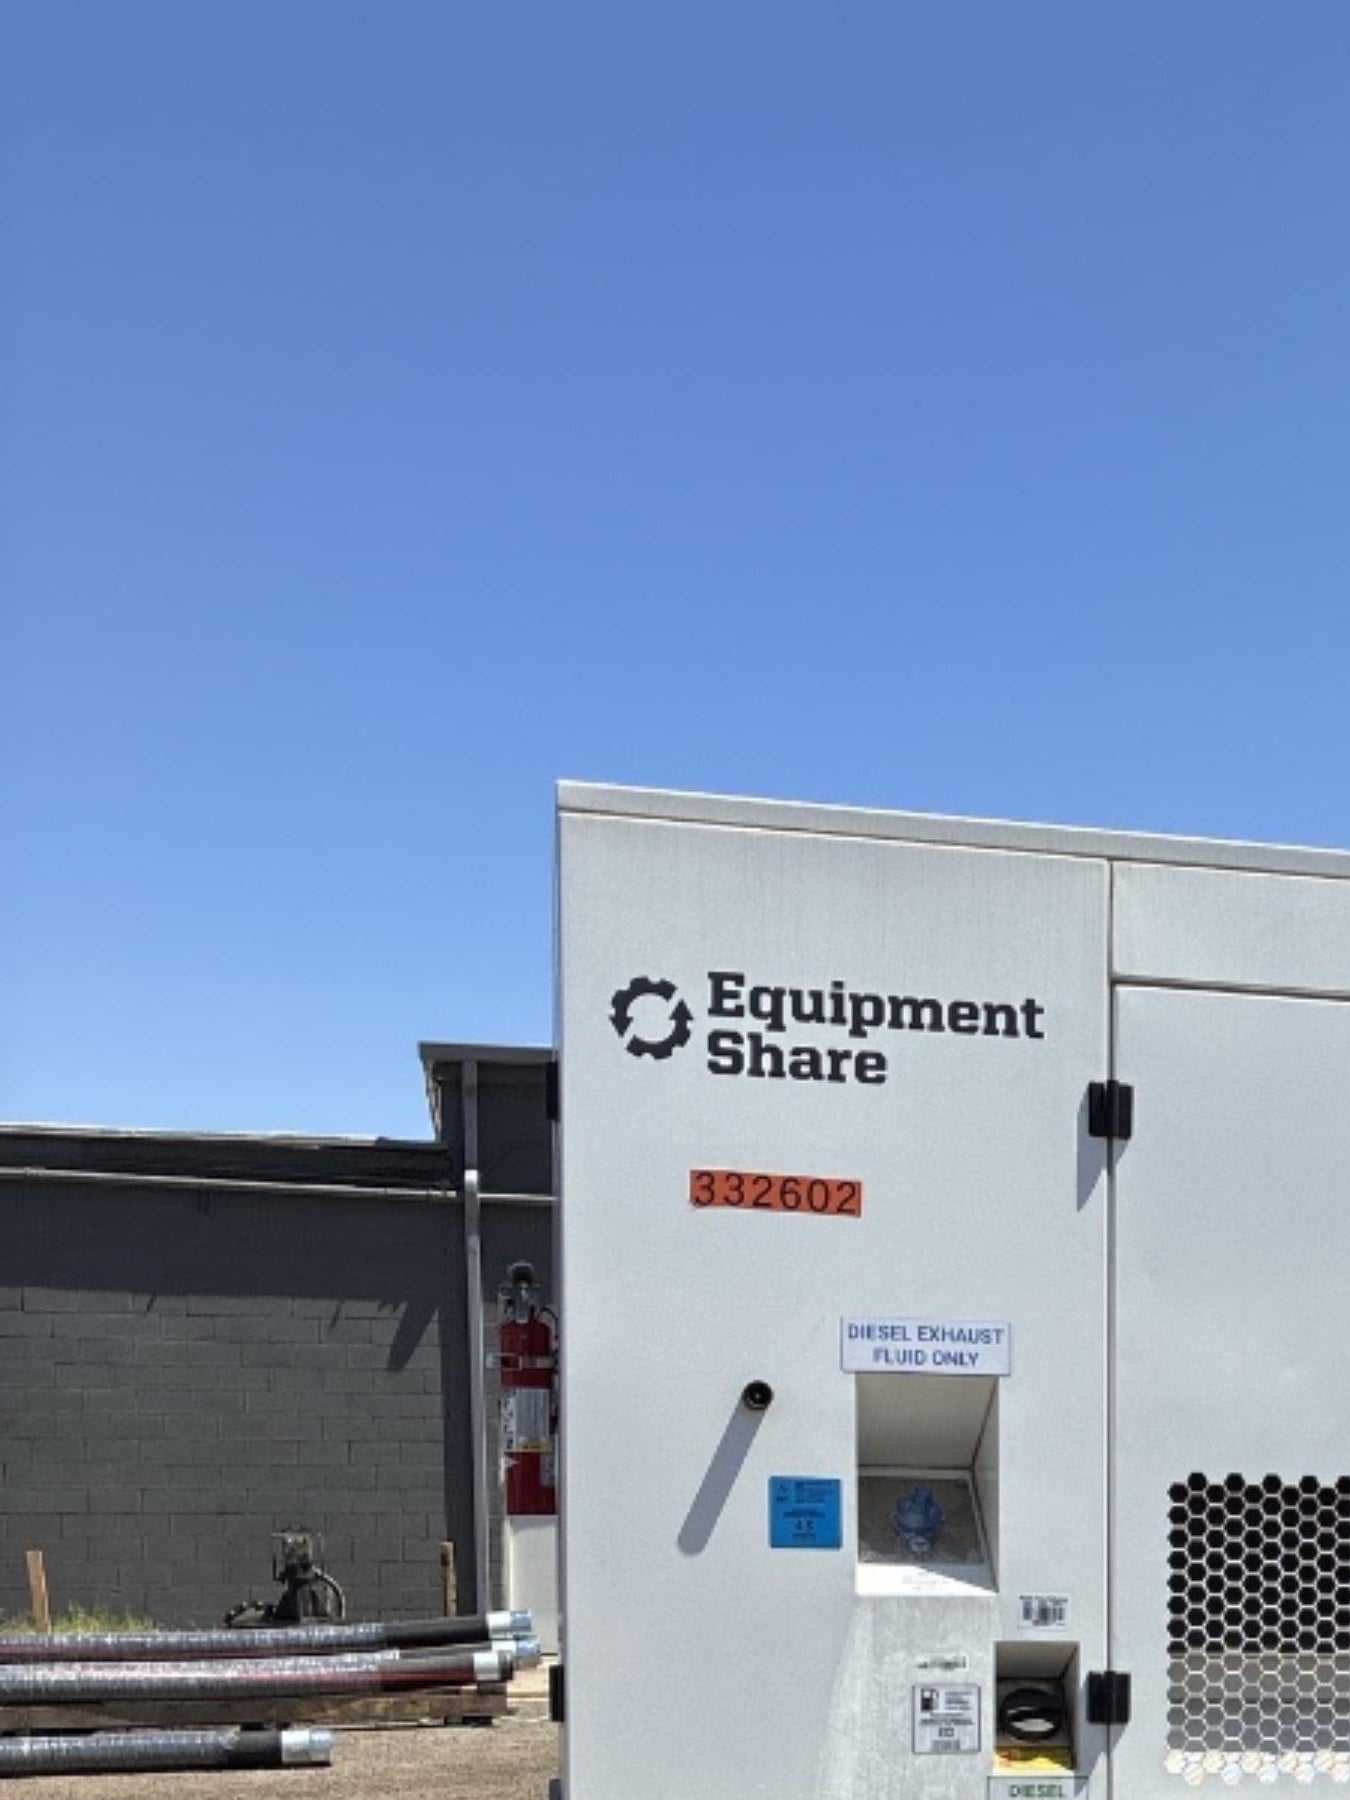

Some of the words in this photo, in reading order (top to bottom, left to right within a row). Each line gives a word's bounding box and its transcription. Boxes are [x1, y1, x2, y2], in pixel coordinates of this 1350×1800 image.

[707, 971, 1045, 1039] Equipment
[707, 1029, 888, 1085] Share
[692, 1171, 858, 1215] 332602
[848, 1323, 912, 1342] DIESEL
[917, 1325, 1006, 1345] EXHAUST
[873, 1347, 926, 1366] FLUID
[932, 1349, 980, 1367] ONLY
[1008, 1784, 1066, 1799] DIESEL
